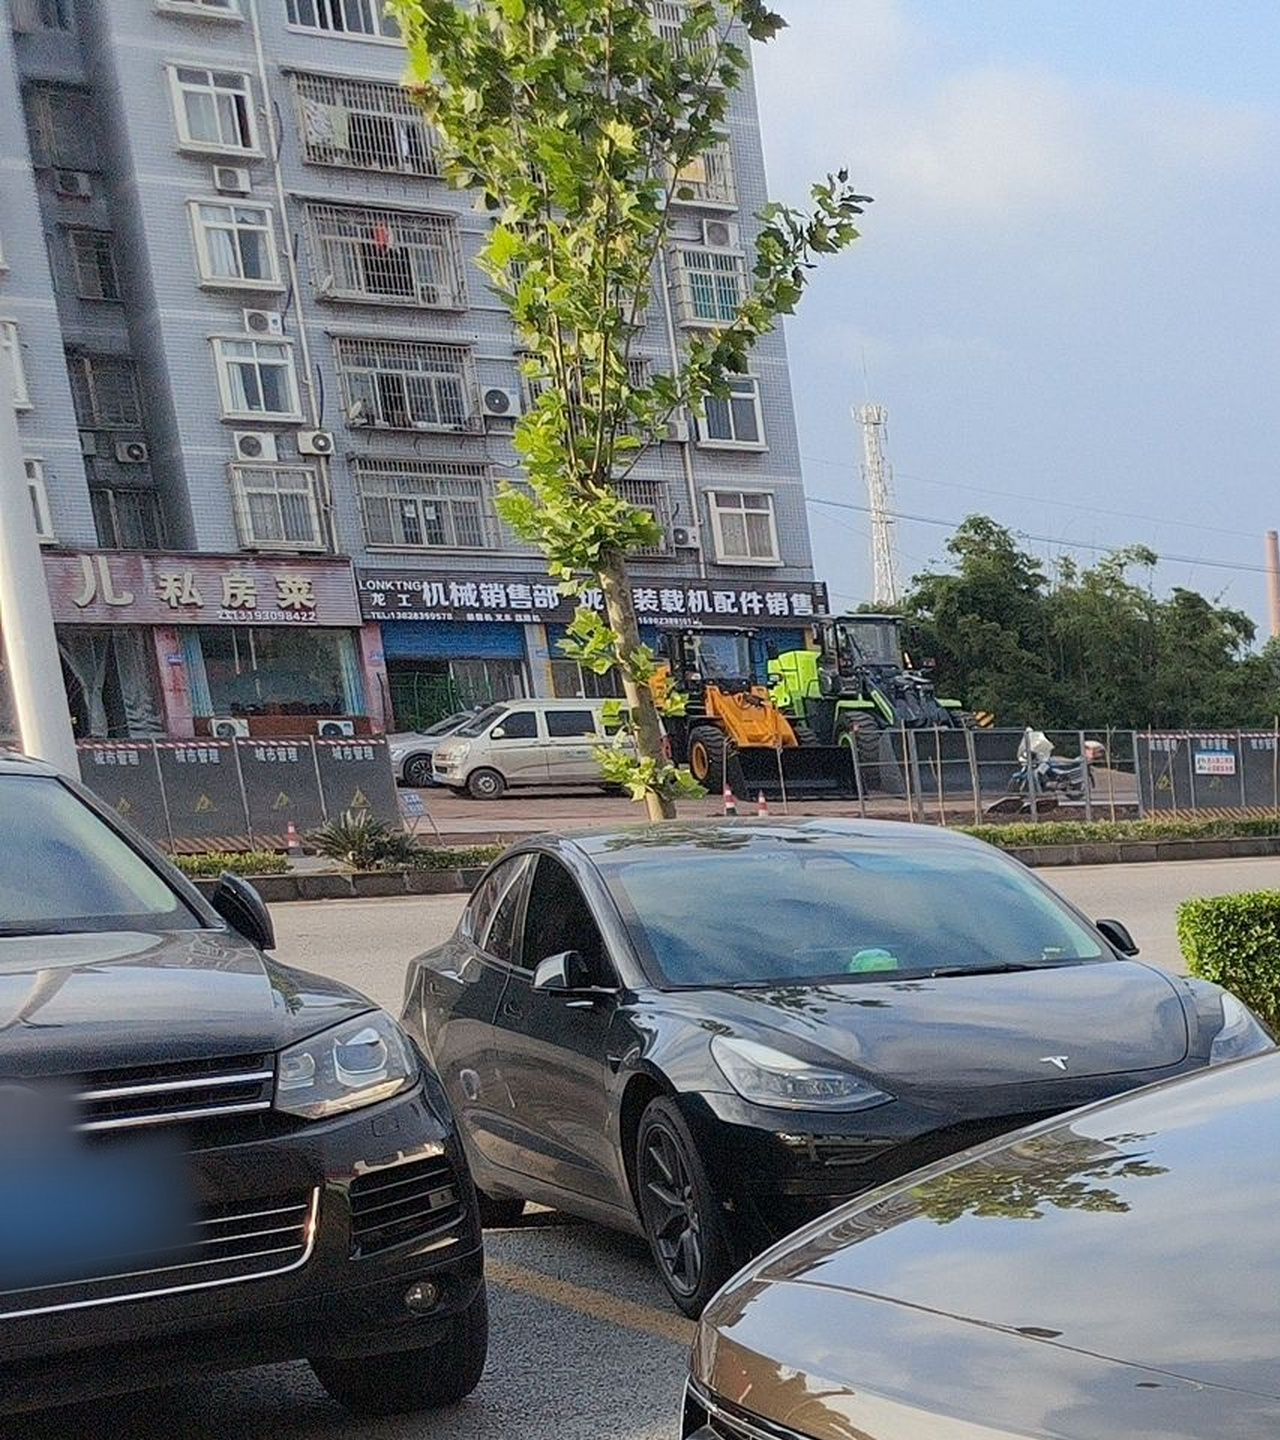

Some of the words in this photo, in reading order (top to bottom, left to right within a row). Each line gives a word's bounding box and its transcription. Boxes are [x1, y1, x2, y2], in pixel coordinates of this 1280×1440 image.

[158, 570, 317, 608] 私房菜
[422, 581, 560, 610] 机械销售部
[633, 588, 814, 617] 装载机配件销售
